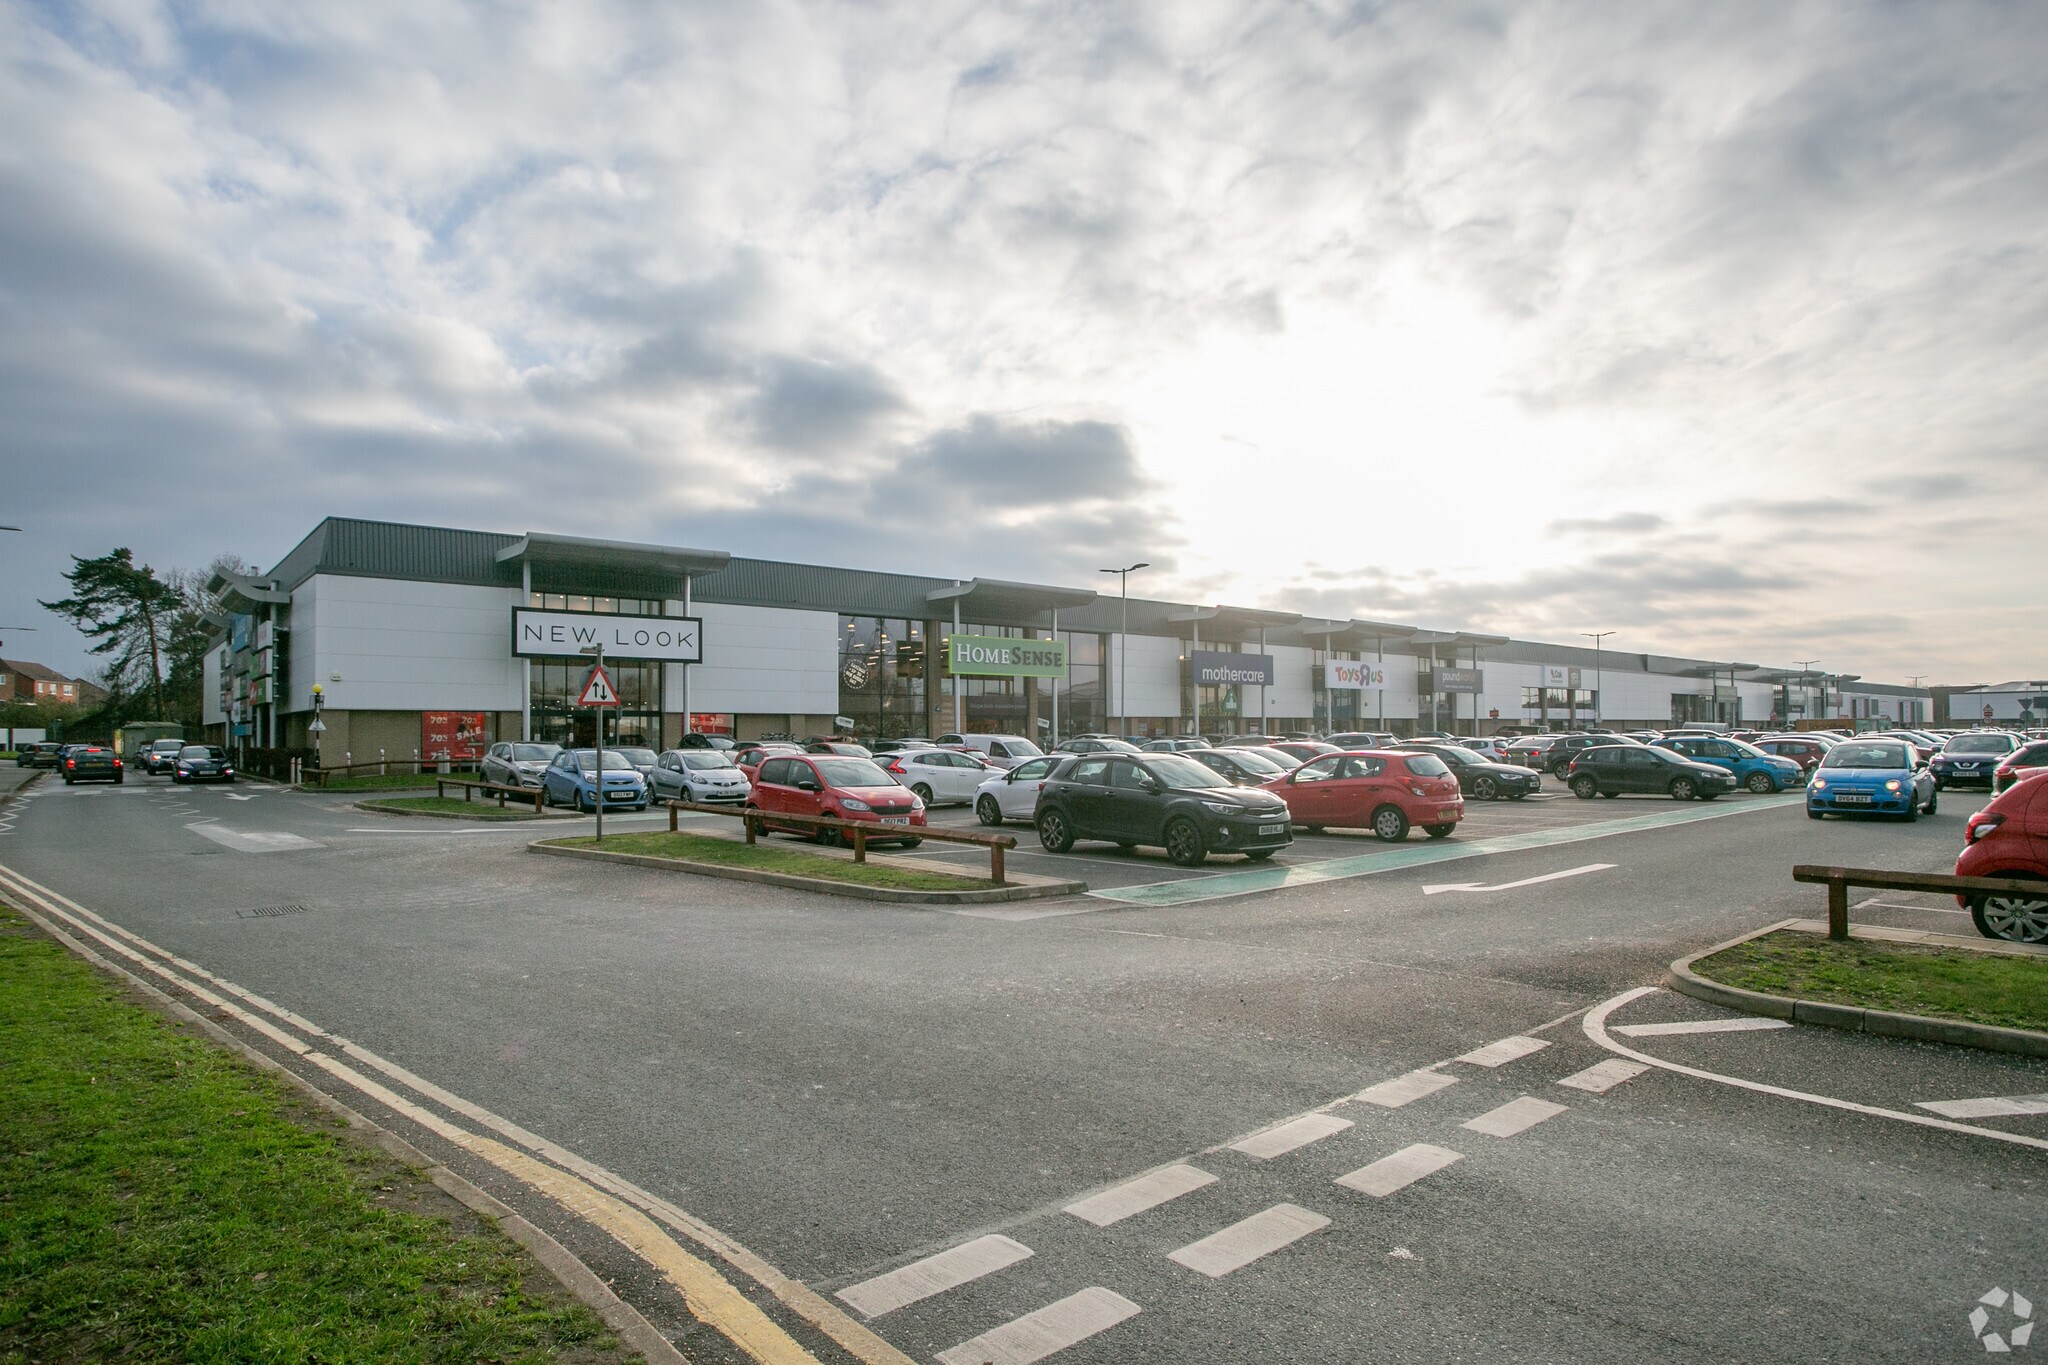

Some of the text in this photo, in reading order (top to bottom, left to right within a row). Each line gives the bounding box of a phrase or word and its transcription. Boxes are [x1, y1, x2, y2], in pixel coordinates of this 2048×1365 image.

[525, 624, 693, 648] NEW LOOK
[1202, 665, 1265, 682] mothercare
[456, 726, 481, 741] SALE
